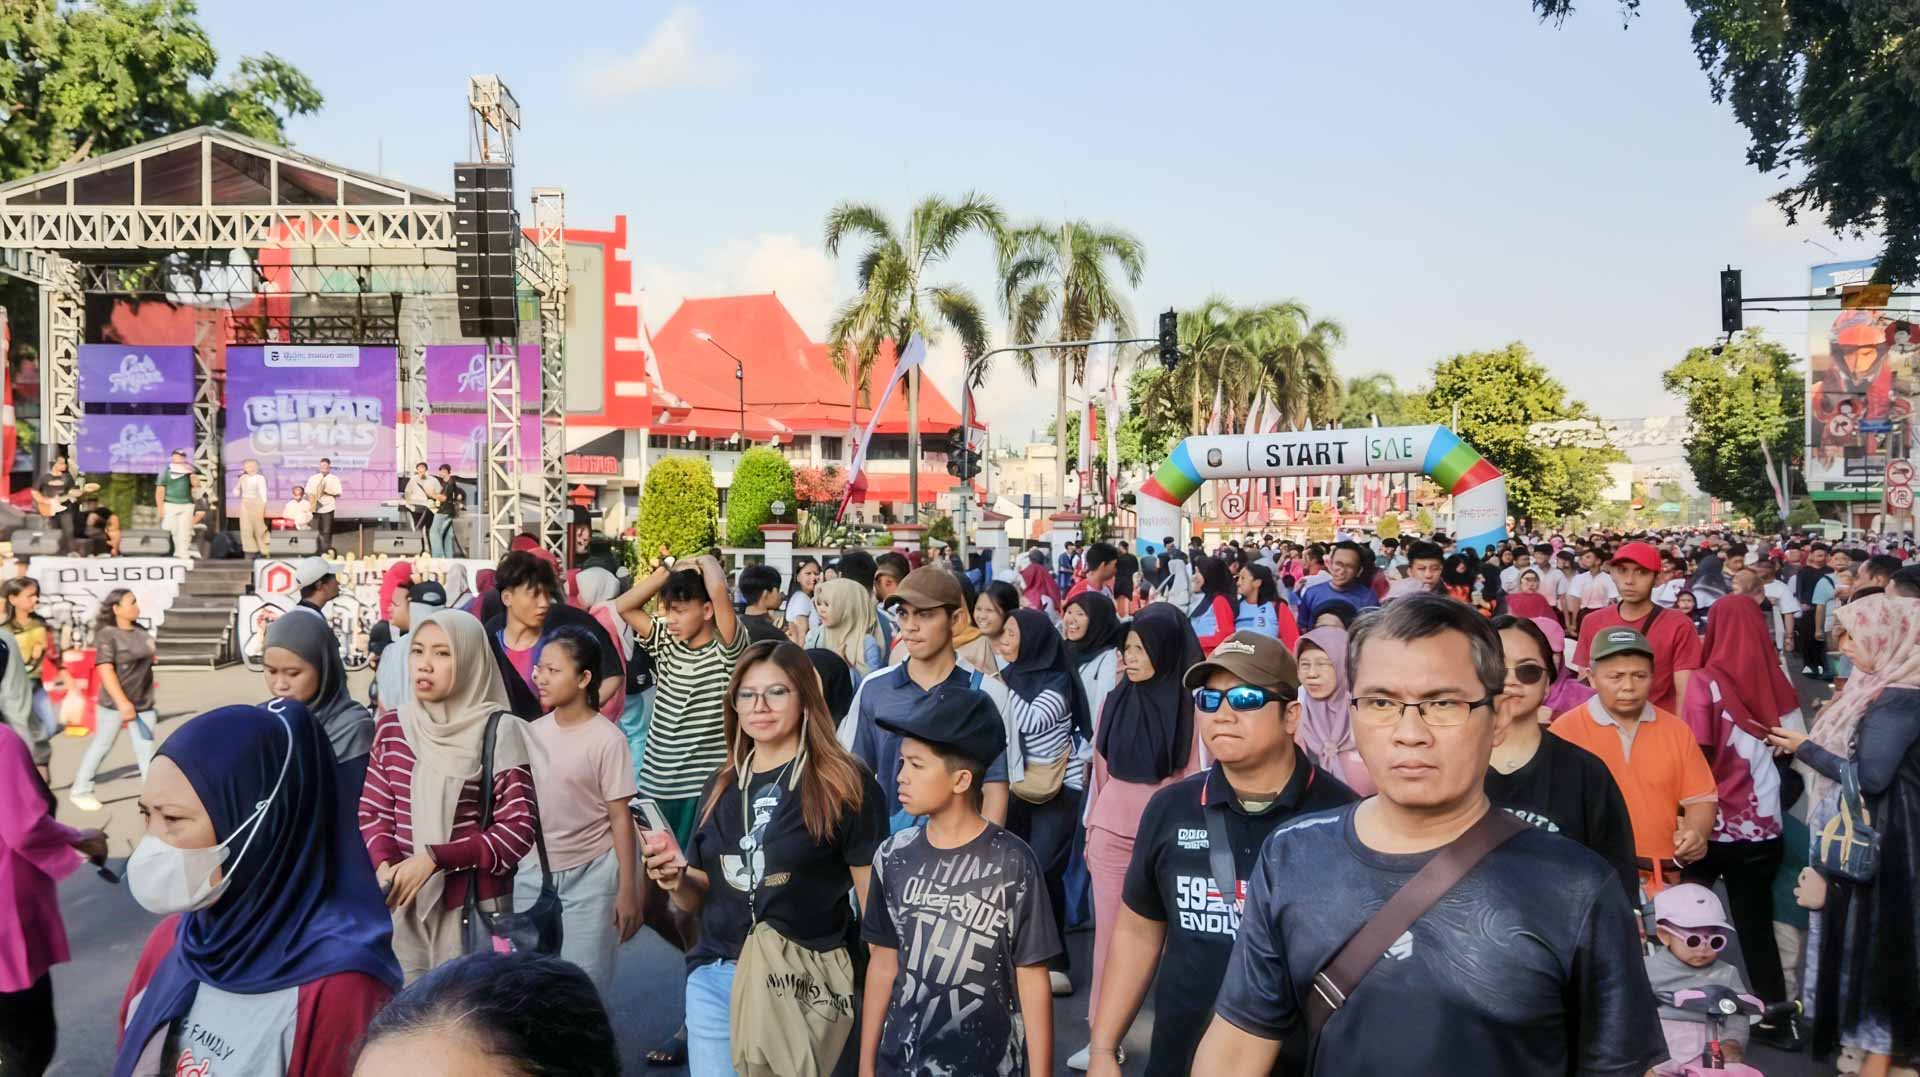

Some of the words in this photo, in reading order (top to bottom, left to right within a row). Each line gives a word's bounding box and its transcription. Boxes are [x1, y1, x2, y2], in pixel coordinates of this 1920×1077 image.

[247, 396, 381, 426] BLITAR
[252, 421, 377, 451] GEMAS
[1266, 442, 1348, 467] START
